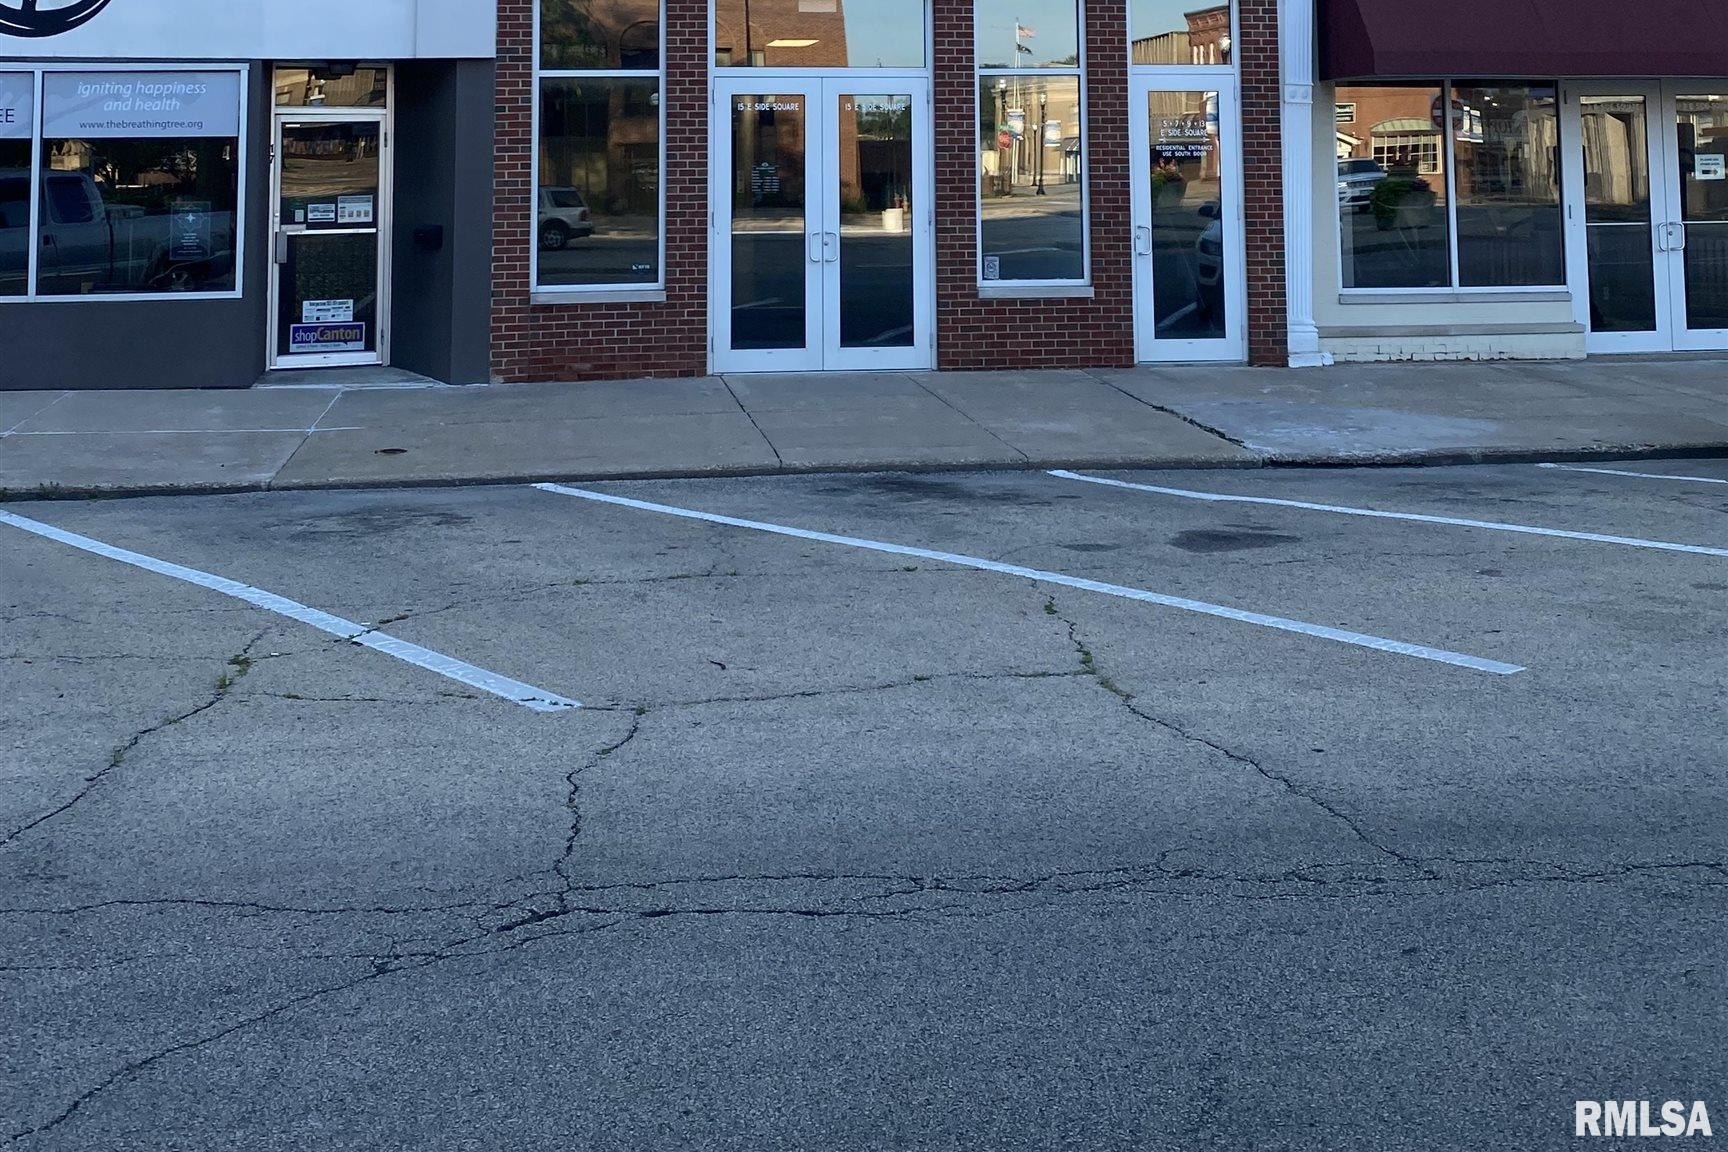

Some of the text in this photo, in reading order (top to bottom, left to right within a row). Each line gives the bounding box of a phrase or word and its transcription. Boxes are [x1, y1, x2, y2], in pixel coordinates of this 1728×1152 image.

[77, 81, 207, 97] igniting happiness
[103, 97, 180, 112] and health
[737, 102, 800, 111] 15 E SIDE SQUARE
[844, 102, 852, 111] 15
[854, 102, 860, 111] E
[79, 119, 204, 130] www.thebreathingtree.org
